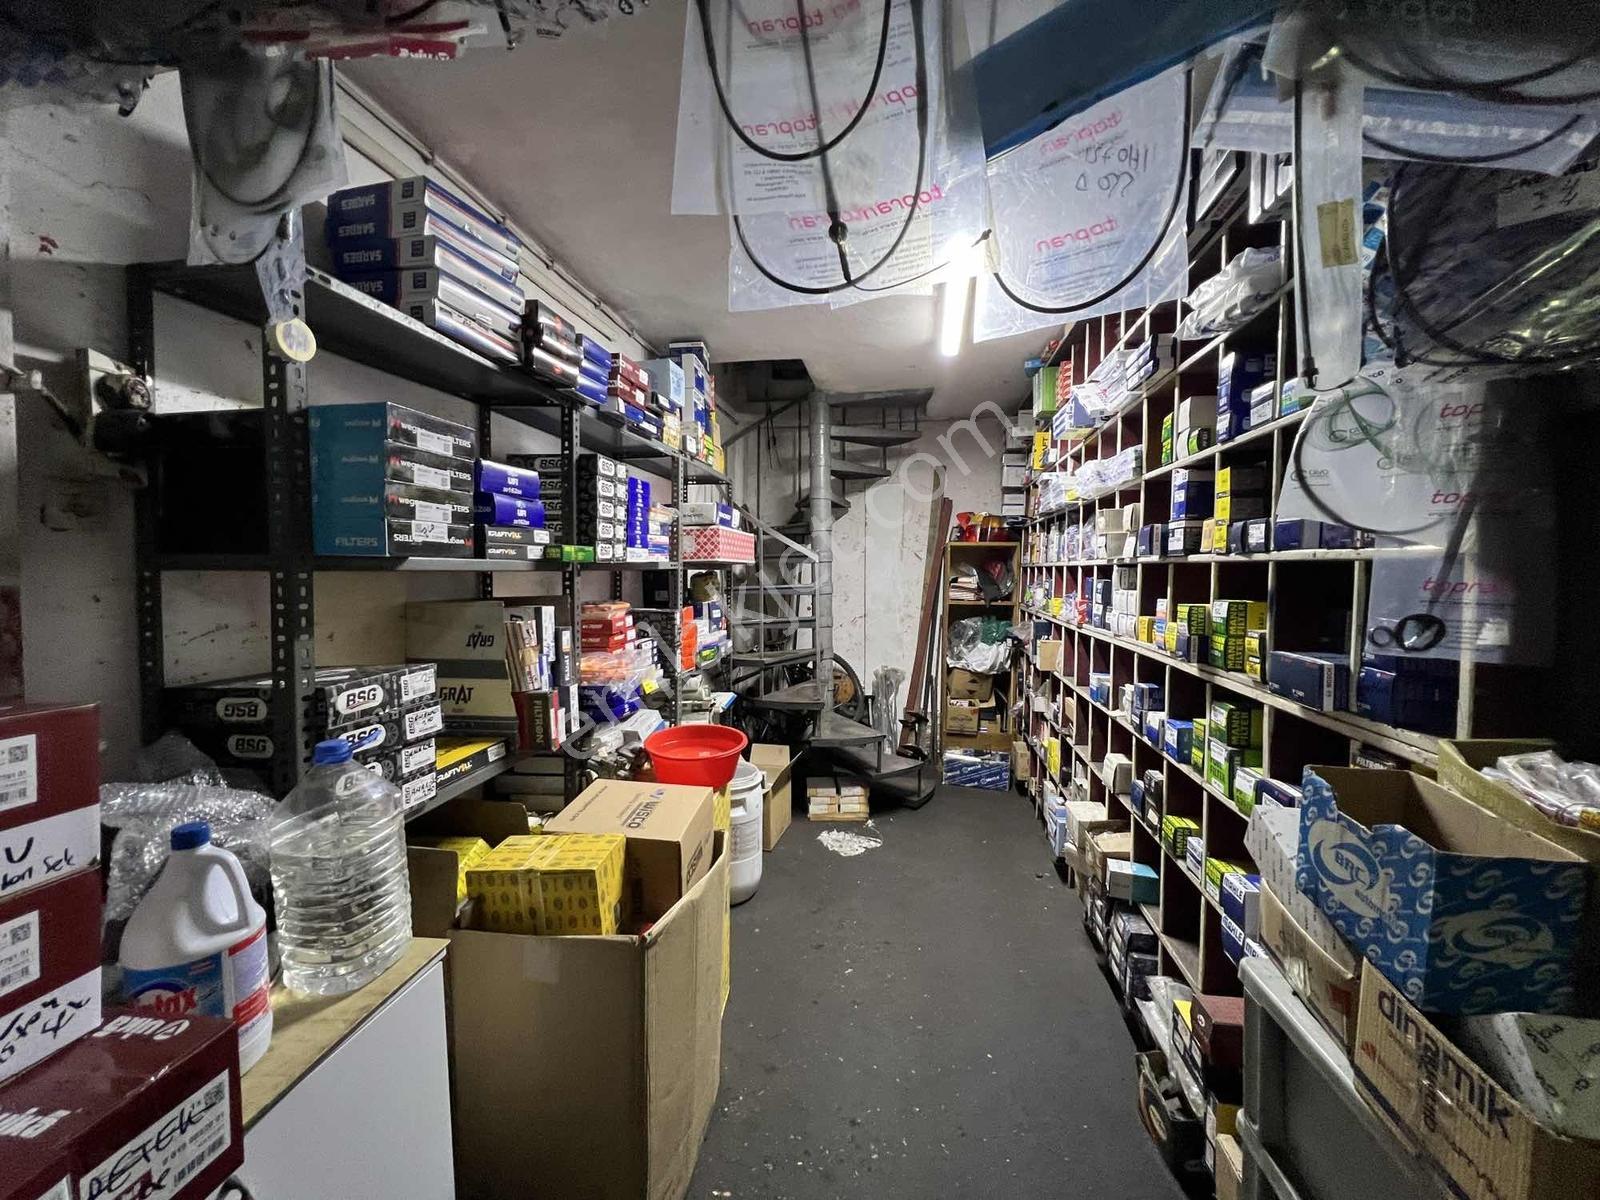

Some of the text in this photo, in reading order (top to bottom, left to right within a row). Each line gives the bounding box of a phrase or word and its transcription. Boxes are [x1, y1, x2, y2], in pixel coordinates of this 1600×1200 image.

[335, 537, 379, 547] FILTERS
[466, 631, 495, 649] GRAT
[346, 687, 377, 710] BSG
[439, 683, 474, 705] GRAT
[224, 701, 259, 718] BSG
[533, 700, 544, 744] FILTRON
[235, 737, 268, 753] BSG
[1223, 876, 1244, 902] MAHLE
[1223, 914, 1244, 944] MAHLE
